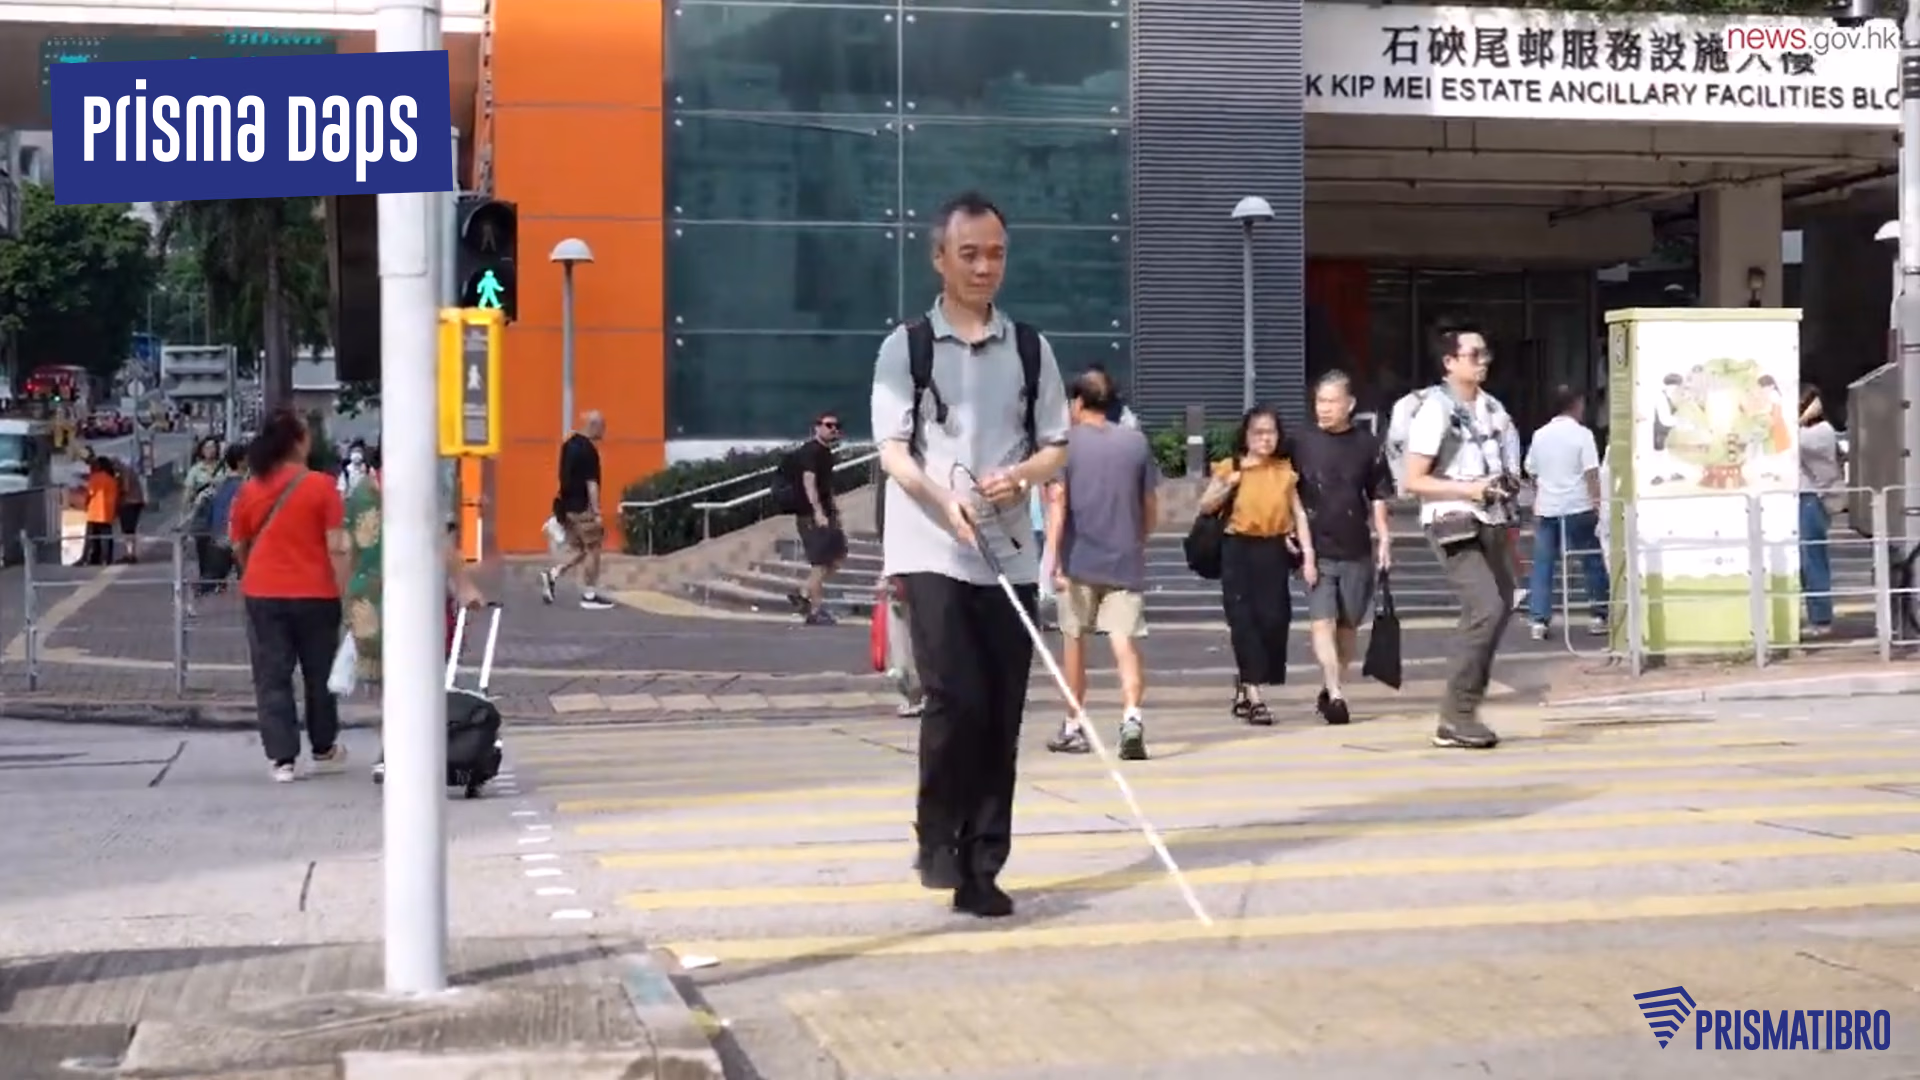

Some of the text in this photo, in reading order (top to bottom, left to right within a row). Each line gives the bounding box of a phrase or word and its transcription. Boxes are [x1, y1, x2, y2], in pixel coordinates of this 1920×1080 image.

[1331, 75, 1375, 98] KIP
[1384, 76, 1431, 99] MEI
[1442, 78, 1542, 102] ESTATE
[1550, 81, 1697, 105] ANCILLARY
[1706, 84, 1844, 109] FACILITIES
